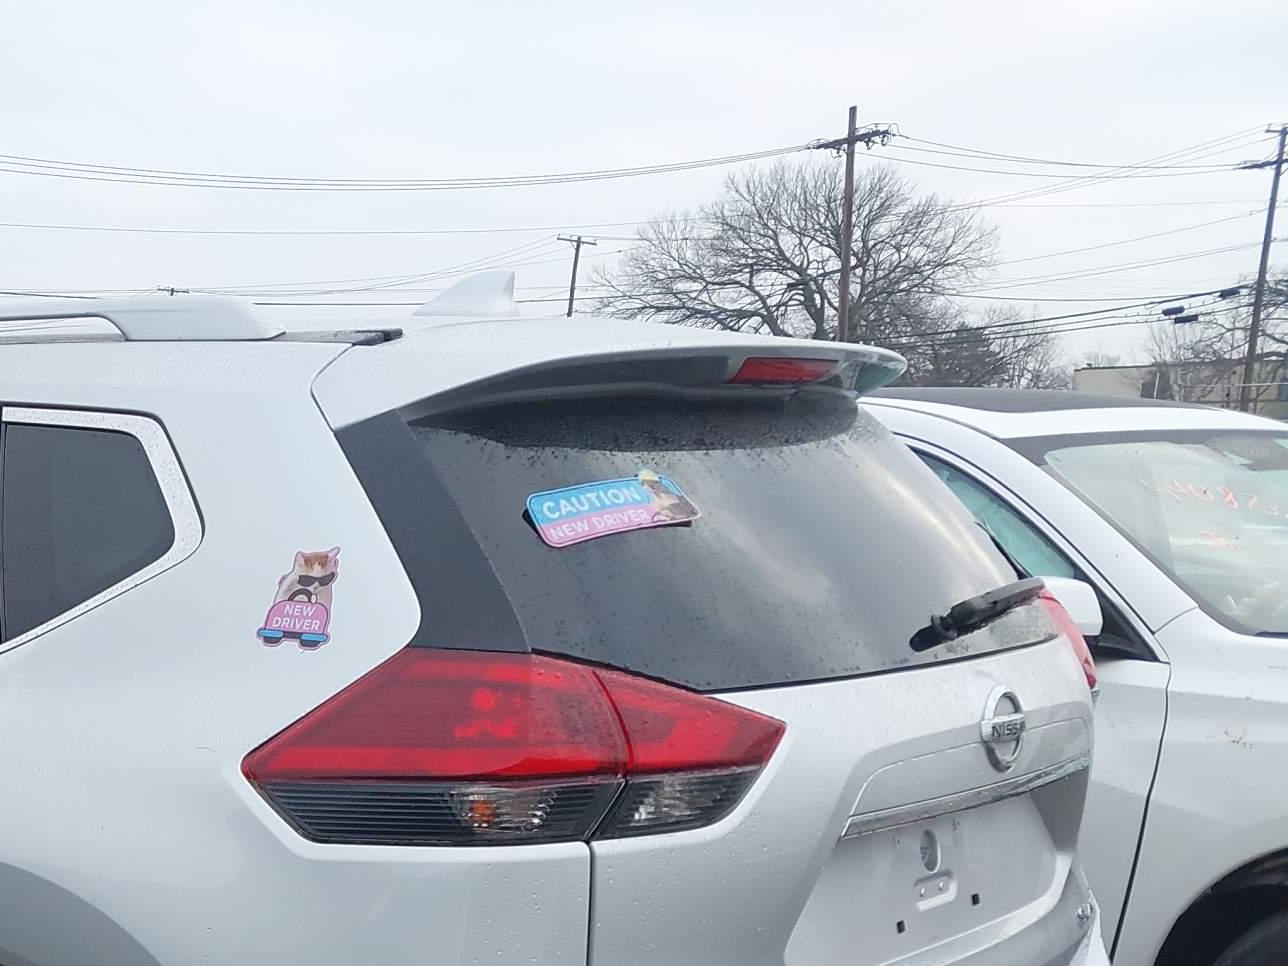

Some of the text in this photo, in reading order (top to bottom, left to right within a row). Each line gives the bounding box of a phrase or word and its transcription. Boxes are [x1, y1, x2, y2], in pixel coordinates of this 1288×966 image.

[543, 487, 642, 519] CAUTION
[550, 509, 651, 540] NEW DRIVER
[284, 604, 316, 617] NEW
[272, 616, 321, 631] DRIVER
